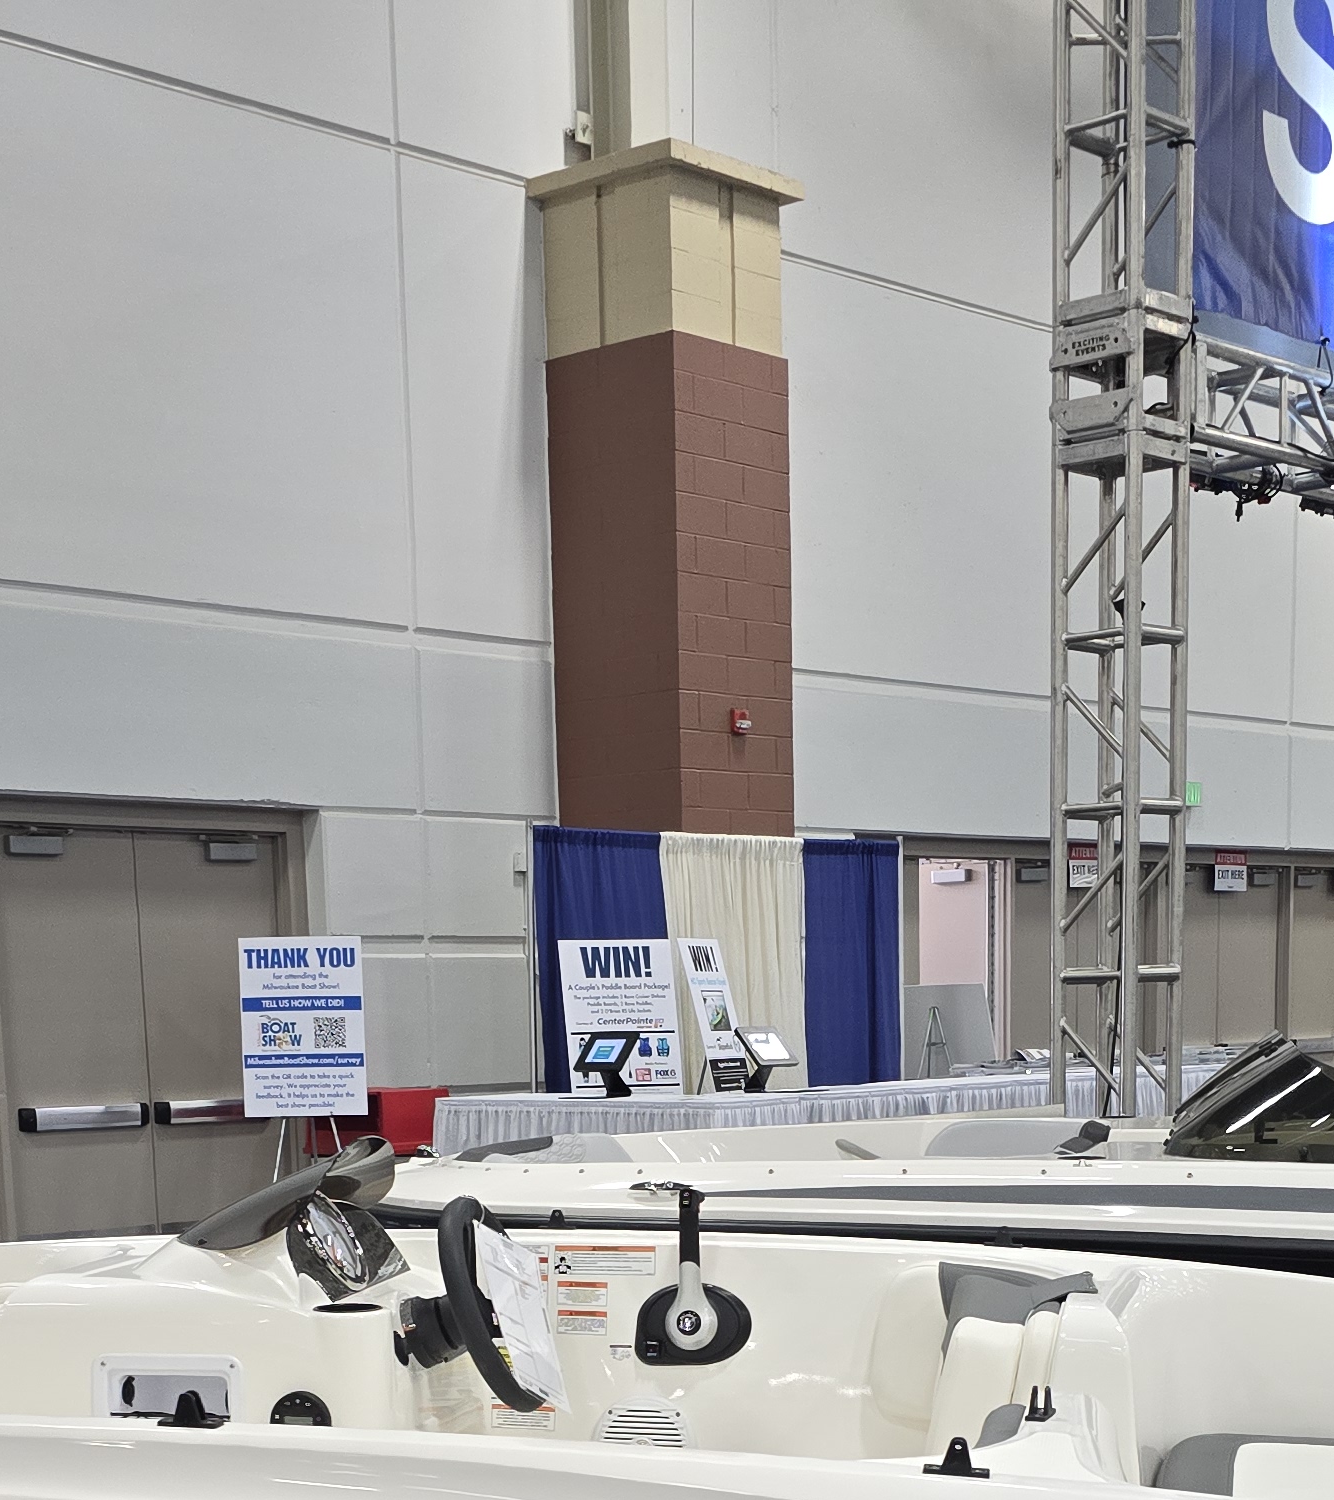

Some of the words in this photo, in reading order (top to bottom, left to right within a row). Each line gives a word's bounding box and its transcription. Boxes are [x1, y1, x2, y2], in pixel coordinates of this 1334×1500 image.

[1071, 334, 1110, 350] EXCITING
[1075, 343, 1107, 357] EVENTS
[1072, 865, 1085, 875] EXIT
[1218, 869, 1229, 880] EXIT
[1231, 869, 1245, 880] HERE
[243, 947, 309, 969] THANK
[315, 946, 355, 968] YOU
[579, 945, 652, 979] WIN!
[687, 945, 719, 972] WIN!
[284, 972, 316, 980] attending
[318, 971, 329, 979] the
[574, 983, 600, 992] Couple's
[643, 982, 671, 991] Package!
[261, 1000, 278, 1008] TELL
[291, 999, 313, 1007] HOW
[313, 999, 326, 1007] WE
[328, 998, 344, 1007] DID!
[597, 1017, 654, 1026] CenterPointe
[261, 1022, 296, 1034] BOAT
[293, 1072, 307, 1080] code
[338, 1072, 354, 1080] quick
[298, 1082, 331, 1090] appreciate
[293, 1091, 309, 1100] helps
[308, 1101, 335, 1109] possible!
